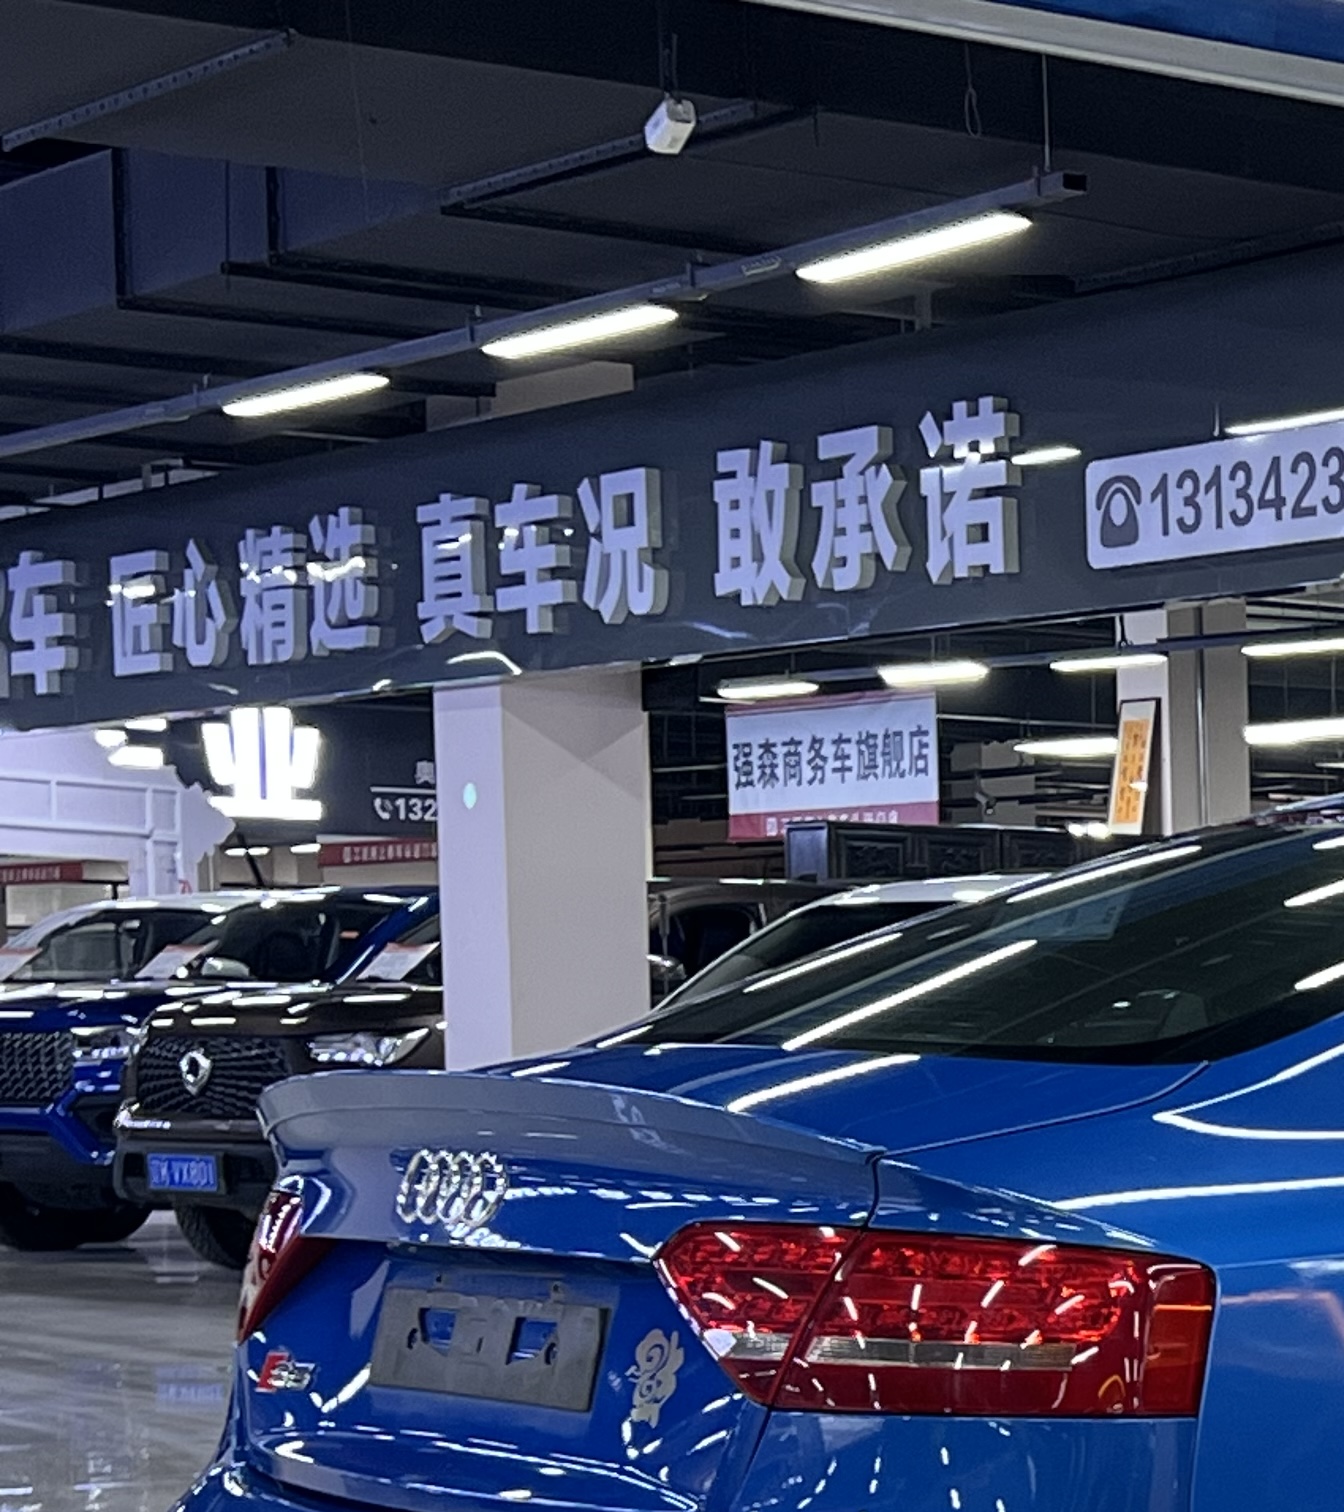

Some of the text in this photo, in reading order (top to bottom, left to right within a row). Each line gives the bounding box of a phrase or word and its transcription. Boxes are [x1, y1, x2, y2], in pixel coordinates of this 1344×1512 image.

[109, 506, 382, 677] 匠心精选
[416, 467, 668, 644] 真车况
[712, 395, 1020, 607] 敢承诺
